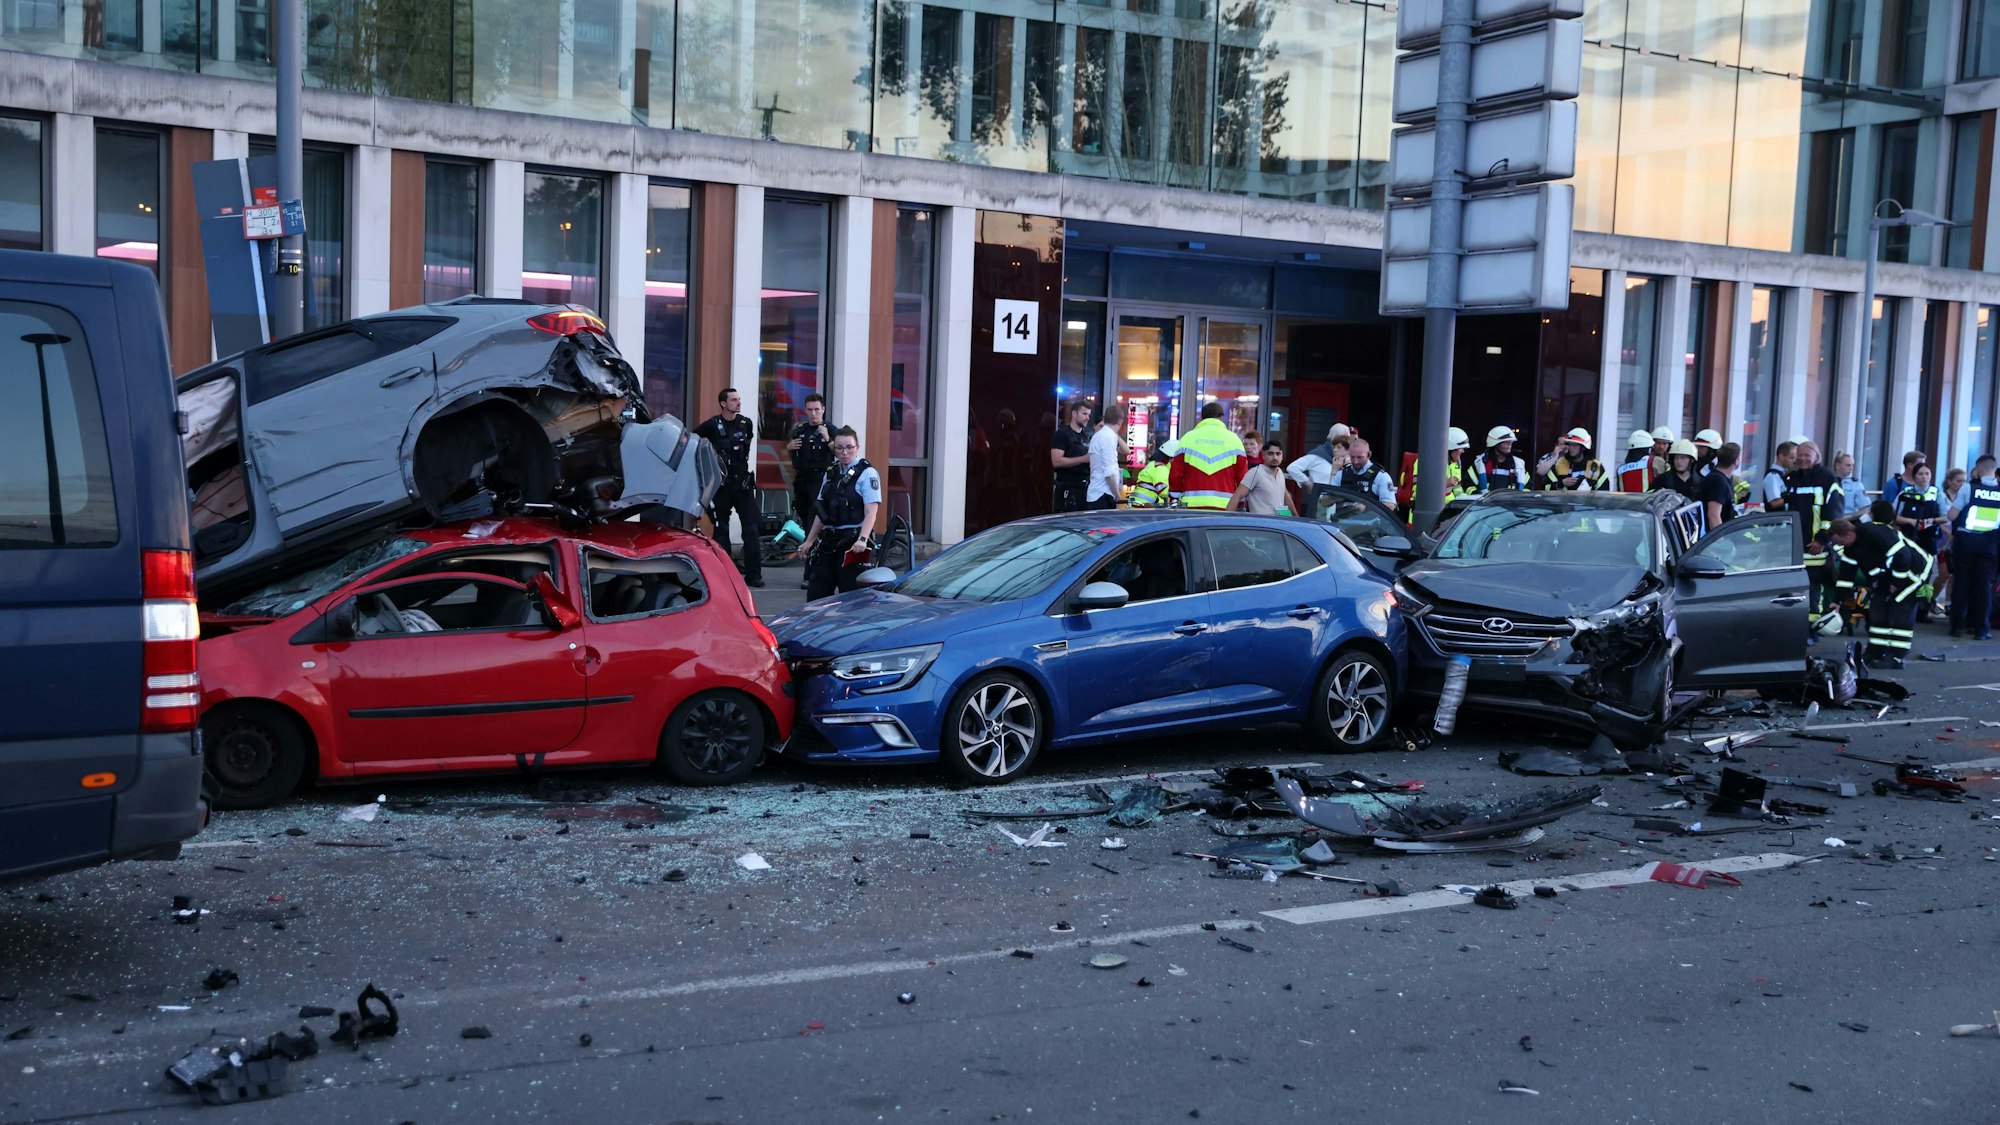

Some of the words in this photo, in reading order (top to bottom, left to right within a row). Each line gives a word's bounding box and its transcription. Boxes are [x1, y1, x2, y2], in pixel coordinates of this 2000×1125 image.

[258, 207, 273, 217] 300
[289, 265, 298, 273] 10
[1002, 312, 1030, 340] 14
